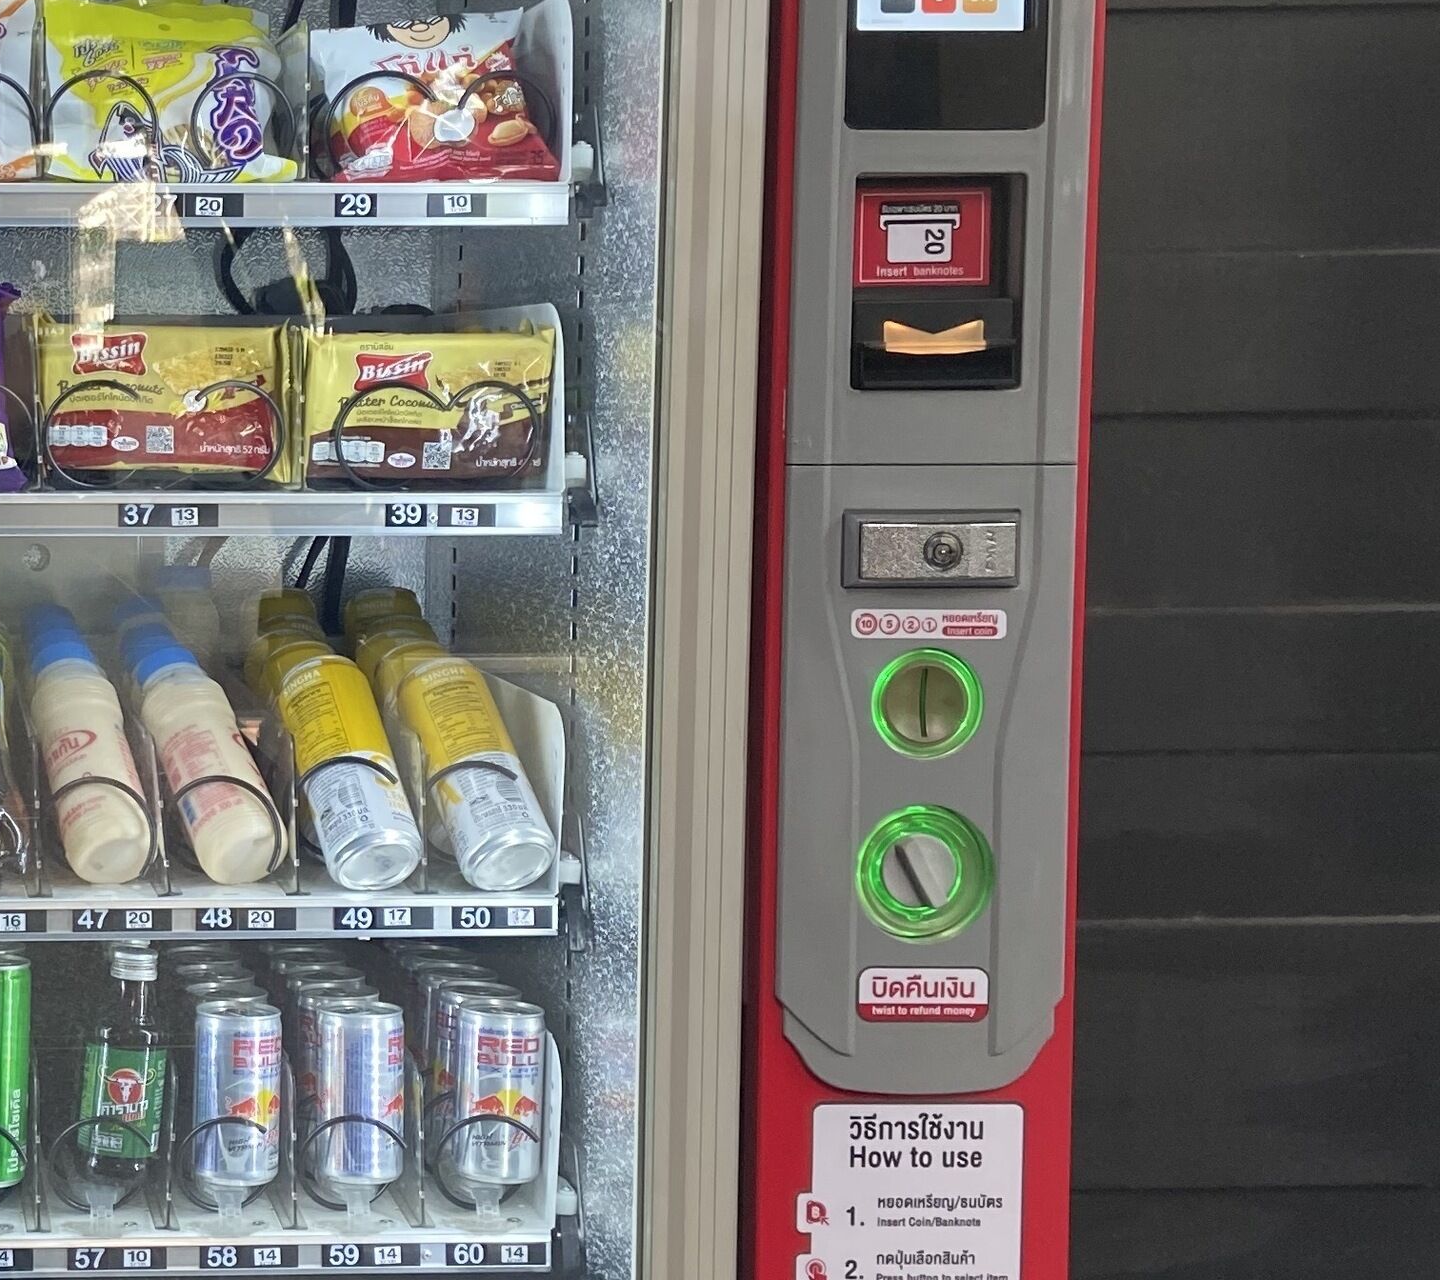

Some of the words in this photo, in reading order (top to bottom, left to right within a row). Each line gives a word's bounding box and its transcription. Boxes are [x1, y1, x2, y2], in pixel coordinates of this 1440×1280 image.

[340, 194, 372, 216] 29
[448, 196, 467, 208] 10
[924, 228, 945, 255] 20
[877, 266, 907, 277] Insert
[913, 266, 964, 276] banknotes
[242, 445, 254, 455] 52
[391, 504, 422, 524] 39
[456, 509, 475, 520] 13
[861, 620, 872, 628] 10
[886, 620, 893, 628] 5
[908, 621, 914, 630] 2
[927, 621, 931, 629] 1
[947, 627, 972, 635] Insert
[283, 670, 320, 696] SINGHA
[341, 907, 373, 928] 49
[388, 909, 406, 921] 17
[872, 974, 975, 998] บิดคืนเงิน
[872, 1005, 895, 1015] twist
[898, 1006, 907, 1015] to
[910, 1006, 940, 1015] refund
[944, 1008, 976, 1018] money
[478, 1037, 539, 1053] RED
[478, 1053, 539, 1066] BULL
[850, 1112, 984, 1141] วิธีการใช้งาน
[849, 1146, 903, 1169] How
[910, 1147, 932, 1168] to
[942, 1151, 983, 1169] use
[877, 1195, 1003, 1212] หยอดเหรียญ/ธนบัตร
[846, 1207, 866, 1227] 1.
[877, 1217, 906, 1227] Insert
[909, 1217, 981, 1228] Coin/Banknote
[453, 1244, 484, 1264] 60
[505, 1248, 525, 1259] 14
[876, 1251, 976, 1272] กดปุ่มเลือกสินค้า
[844, 1260, 865, 1280] 2.
